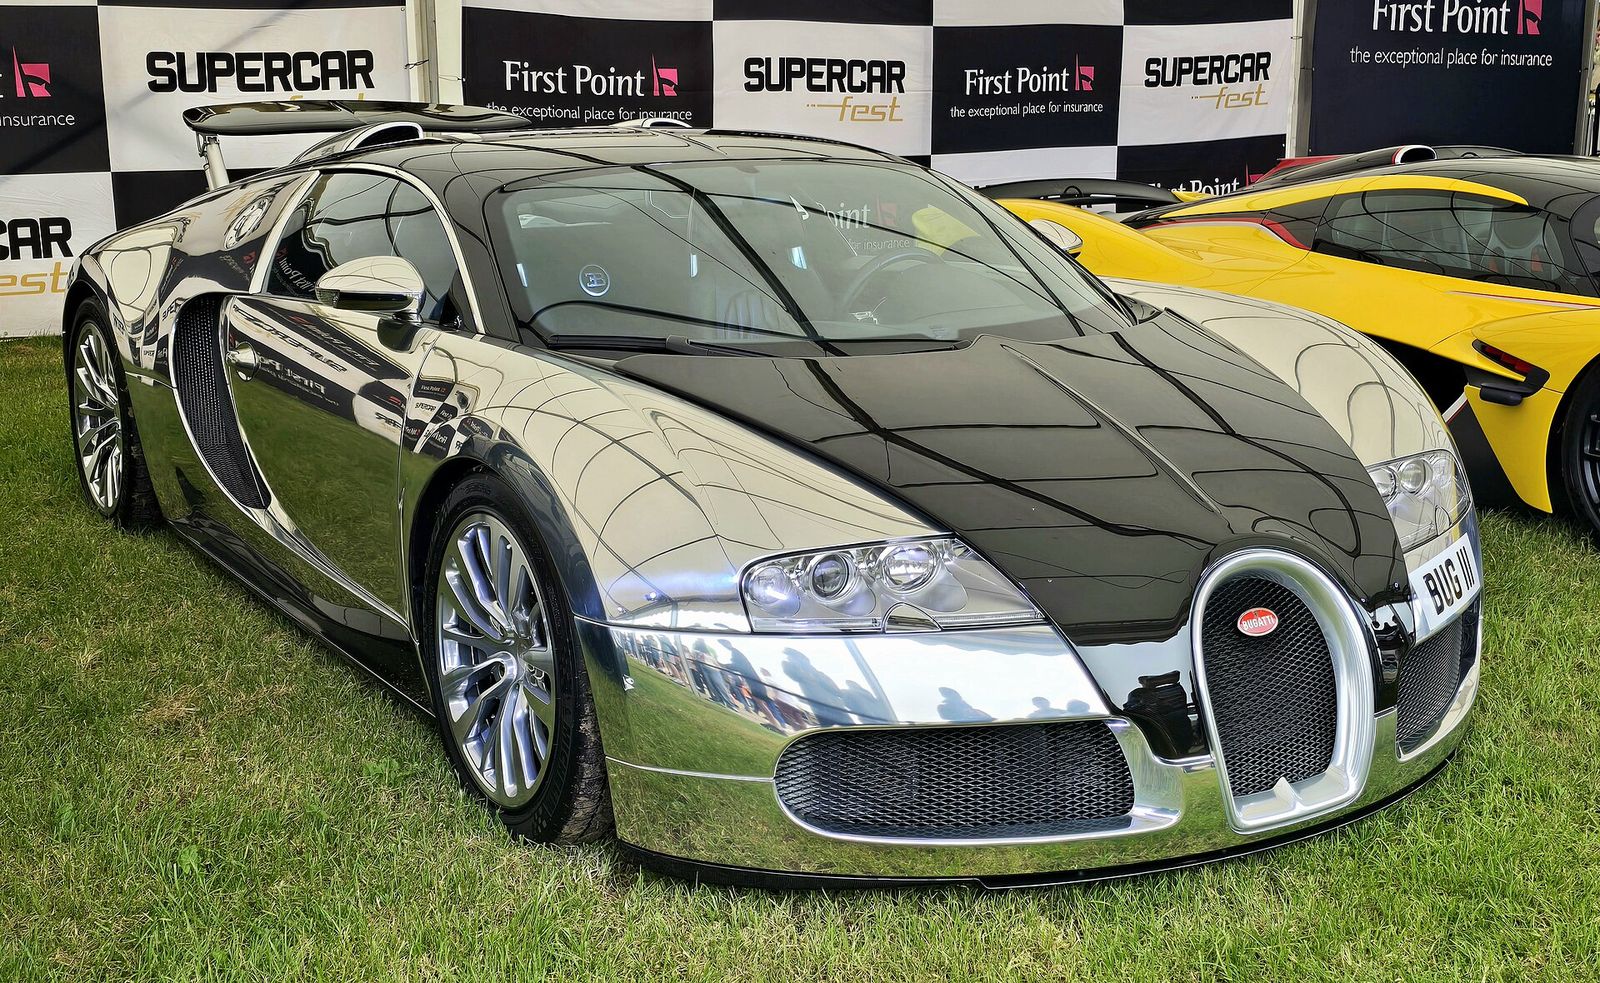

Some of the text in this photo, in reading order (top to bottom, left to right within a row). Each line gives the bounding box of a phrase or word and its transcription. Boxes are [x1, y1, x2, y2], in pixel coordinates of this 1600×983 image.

[1373, 0, 1510, 35] First Point
[146, 50, 375, 93] SUPERCAR
[1144, 52, 1271, 88] SUPERCAR
[1350, 46, 1552, 69] the exceptional place for insurance
[503, 60, 645, 97] First Point
[744, 57, 905, 93] SUPERCAR
[965, 66, 1069, 96] First Point
[817, 96, 903, 121] fest
[950, 101, 1104, 120] the exceptional place for insurance
[1200, 83, 1268, 109] fest
[511, 104, 580, 121] exceptional
[584, 106, 615, 122] place
[618, 107, 636, 120] for
[639, 107, 693, 120] insurance
[1423, 557, 1459, 616] BUG
[1241, 614, 1275, 630] BUGATTI
